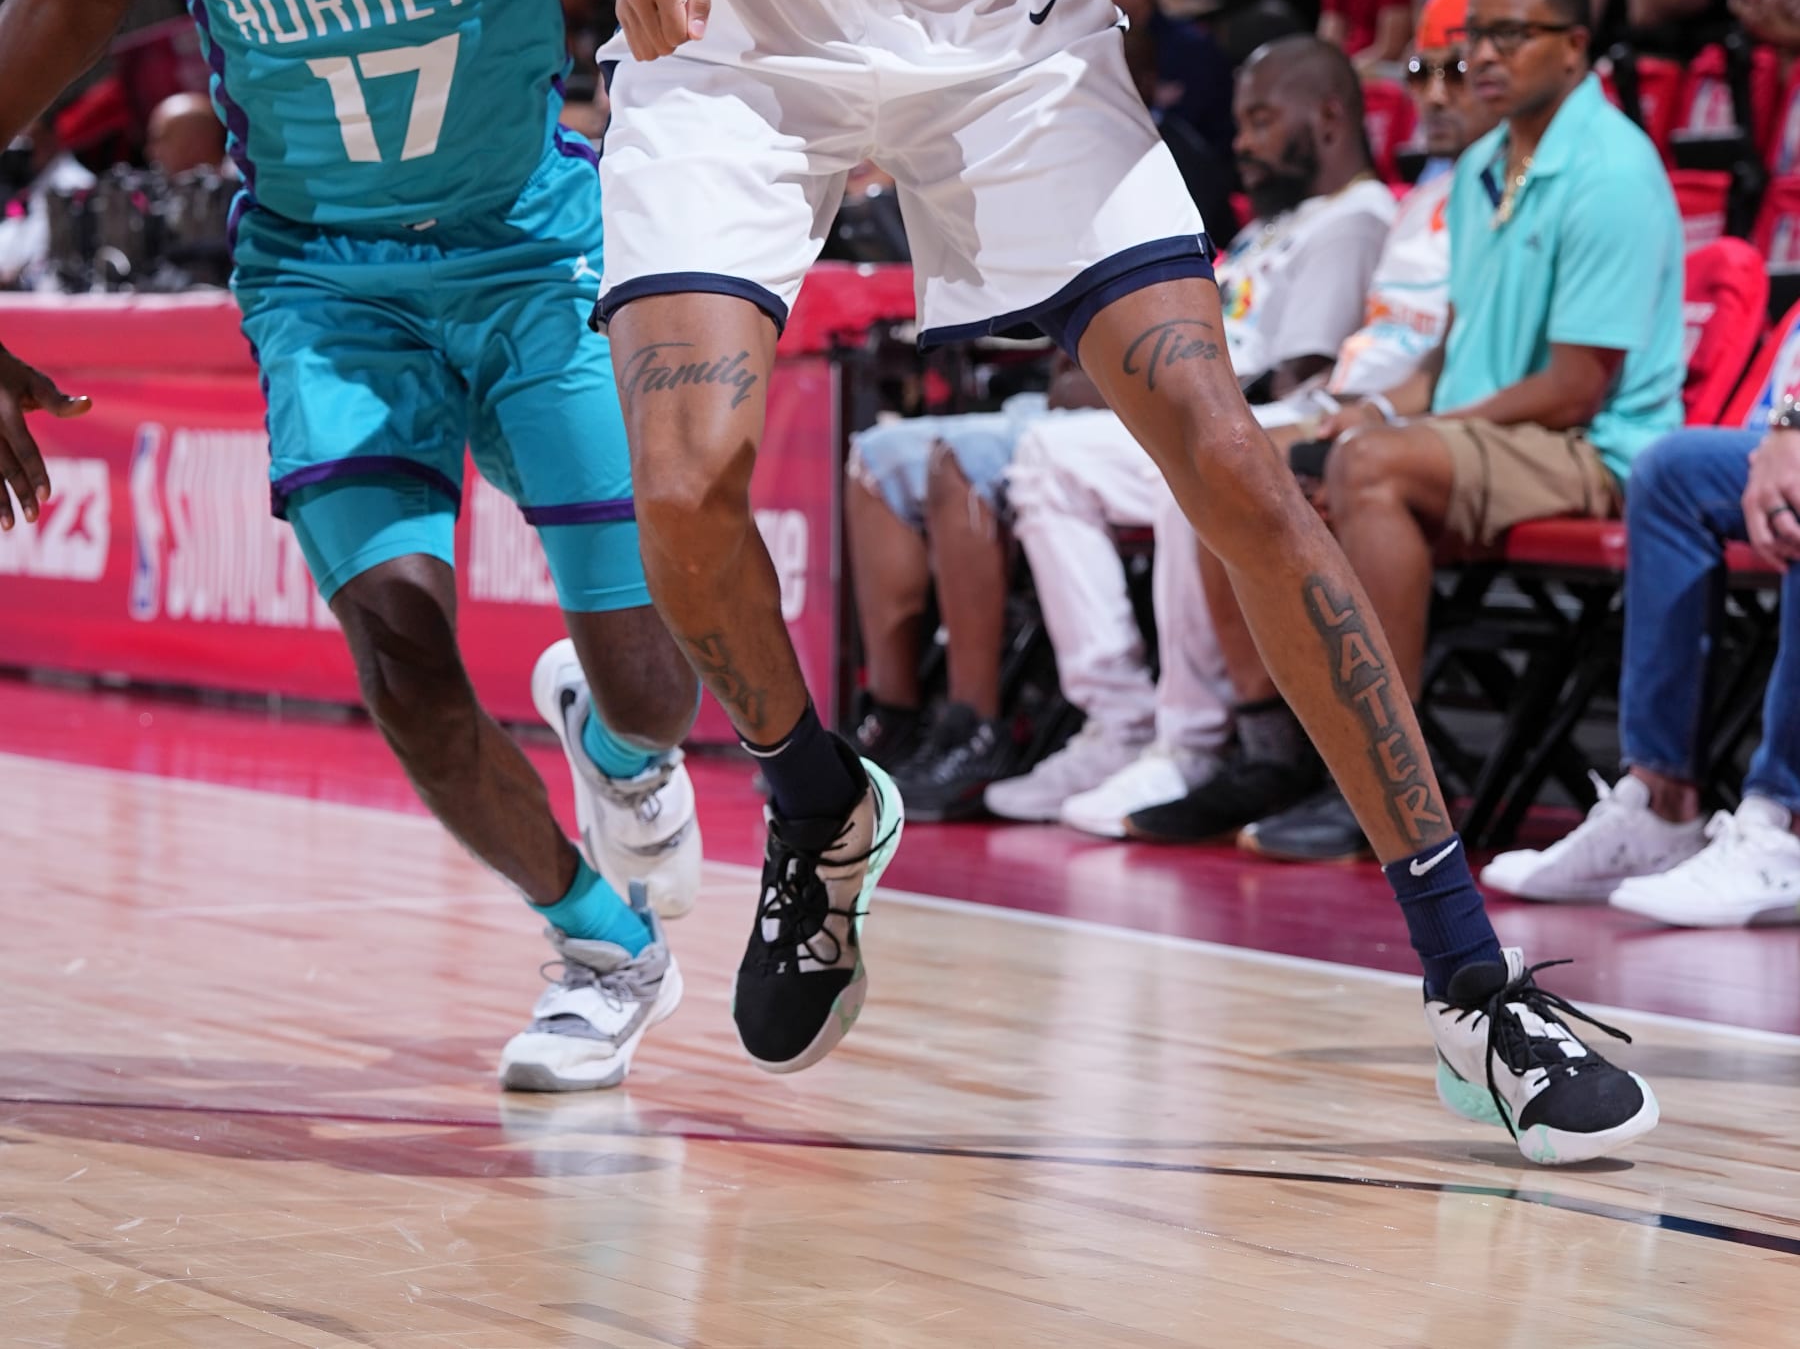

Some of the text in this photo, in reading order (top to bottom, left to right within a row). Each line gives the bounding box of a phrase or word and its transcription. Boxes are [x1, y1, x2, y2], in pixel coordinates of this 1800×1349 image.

[305, 33, 460, 163] 17
[620, 343, 758, 415] Family
[1309, 581, 1444, 843] LATER
